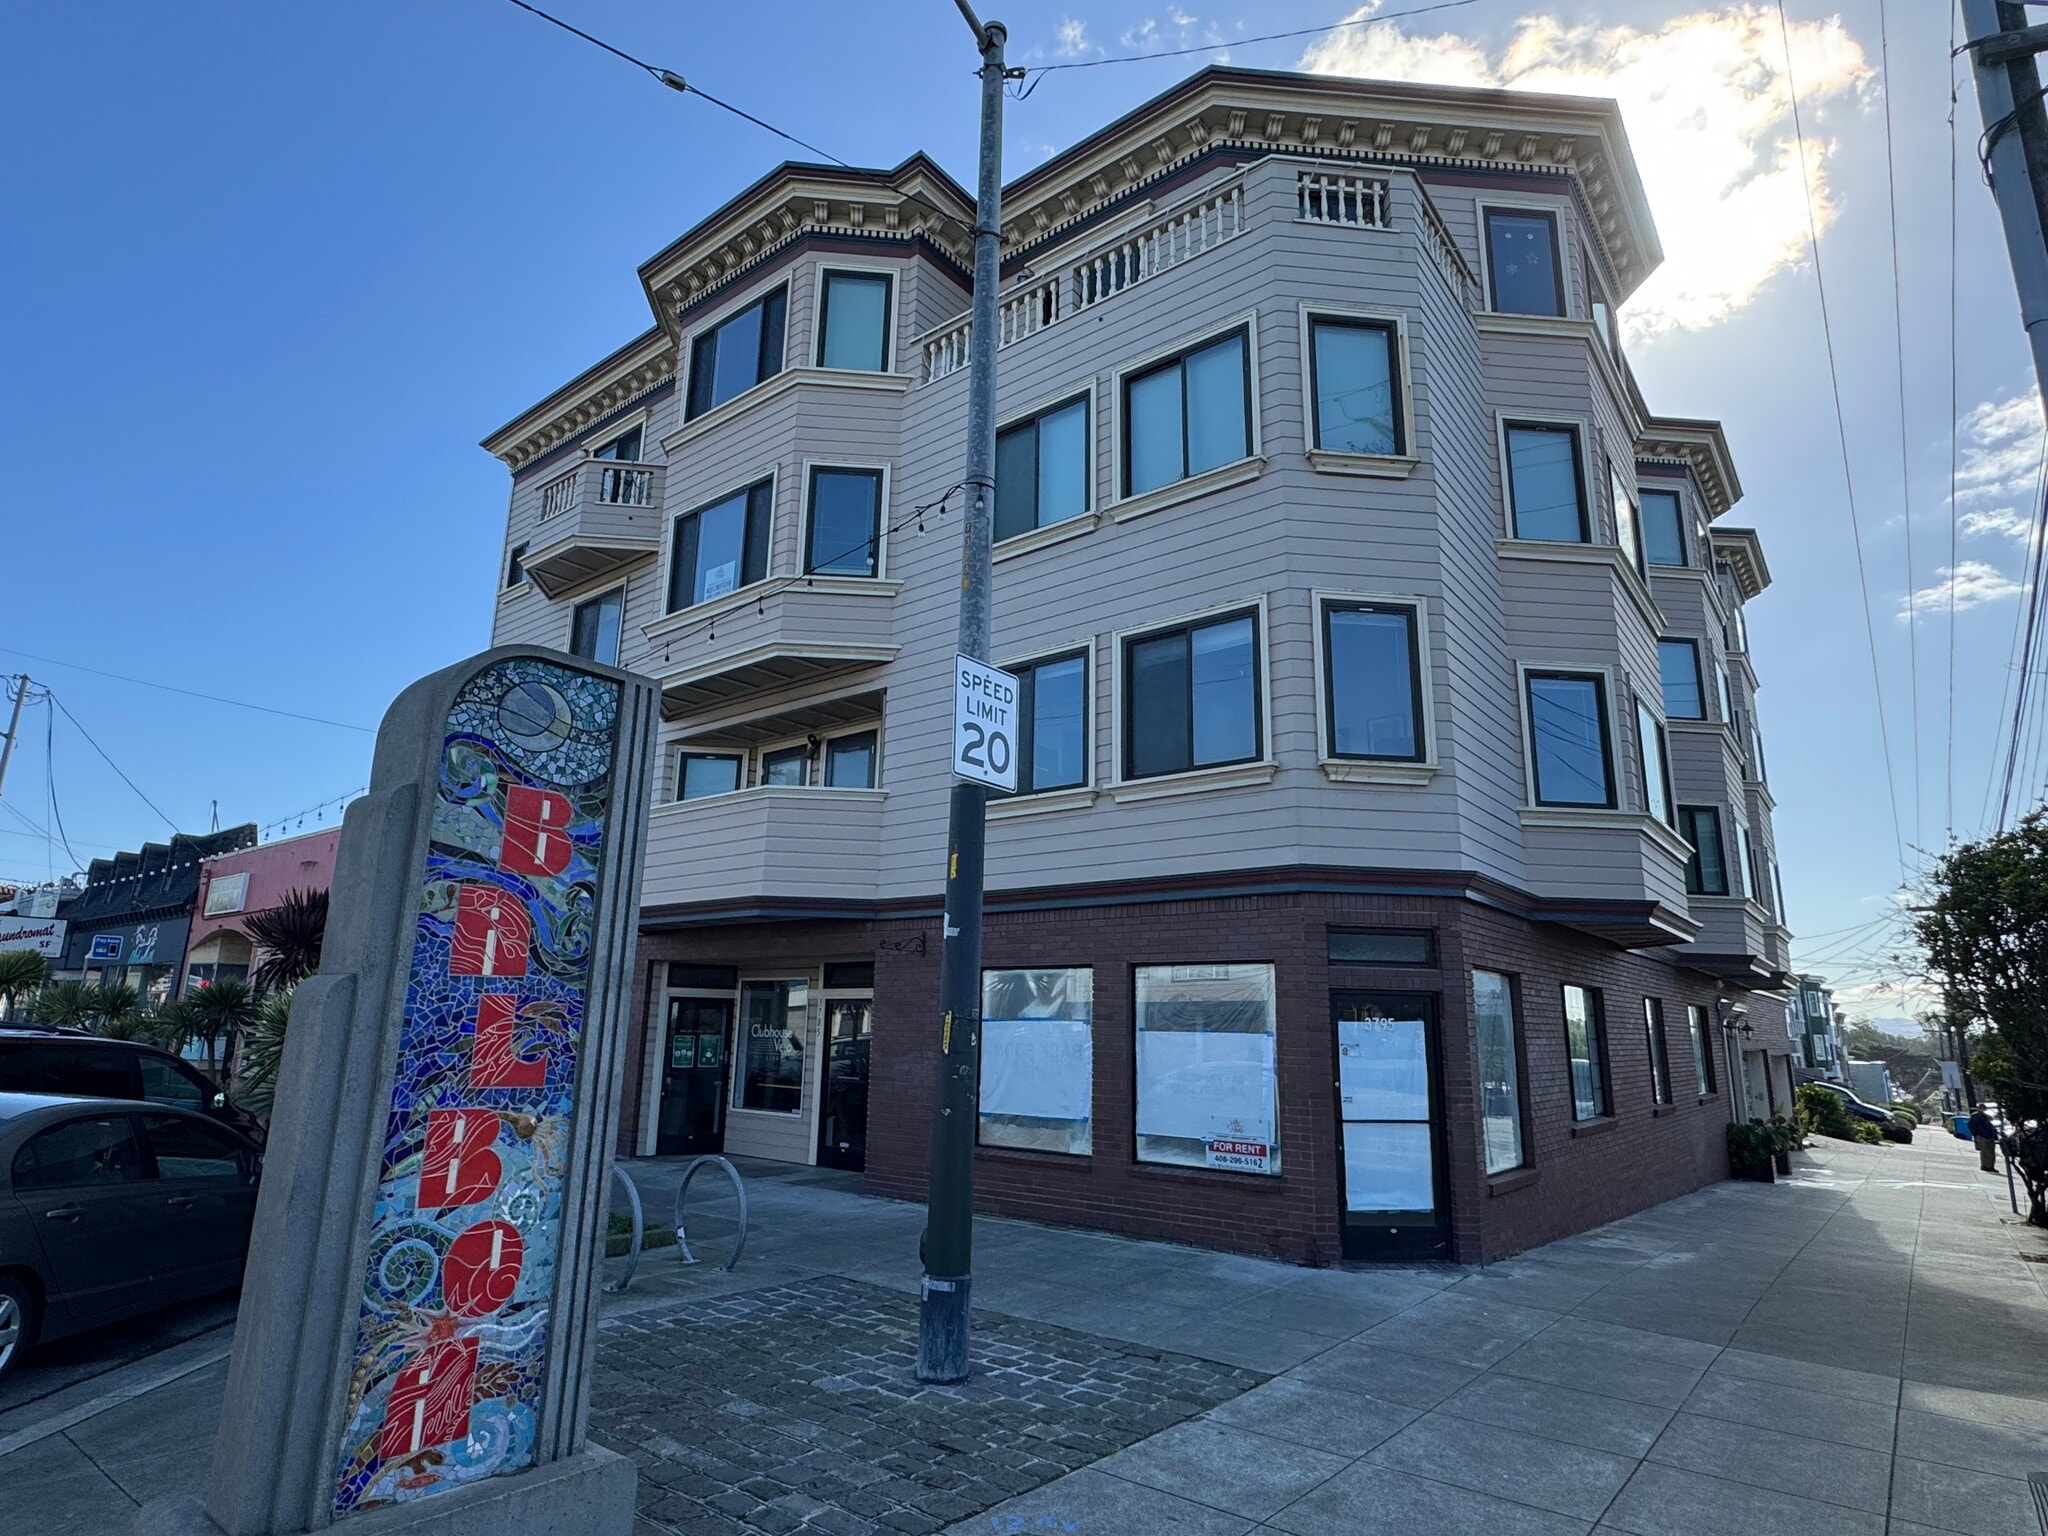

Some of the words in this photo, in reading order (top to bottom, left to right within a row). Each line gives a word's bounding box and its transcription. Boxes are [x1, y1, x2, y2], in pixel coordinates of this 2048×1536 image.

[961, 670, 1013, 704] SPEED
[966, 696, 1007, 726] LIMIT
[961, 721, 1010, 774] 20
[0, 923, 54, 942] undromat
[39, 940, 51, 948] SF
[751, 1023, 794, 1038] Clubhouse
[1364, 1017, 1394, 1031] 3795
[1213, 1141, 1233, 1152] FOR
[1235, 1143, 1261, 1154] RENT
